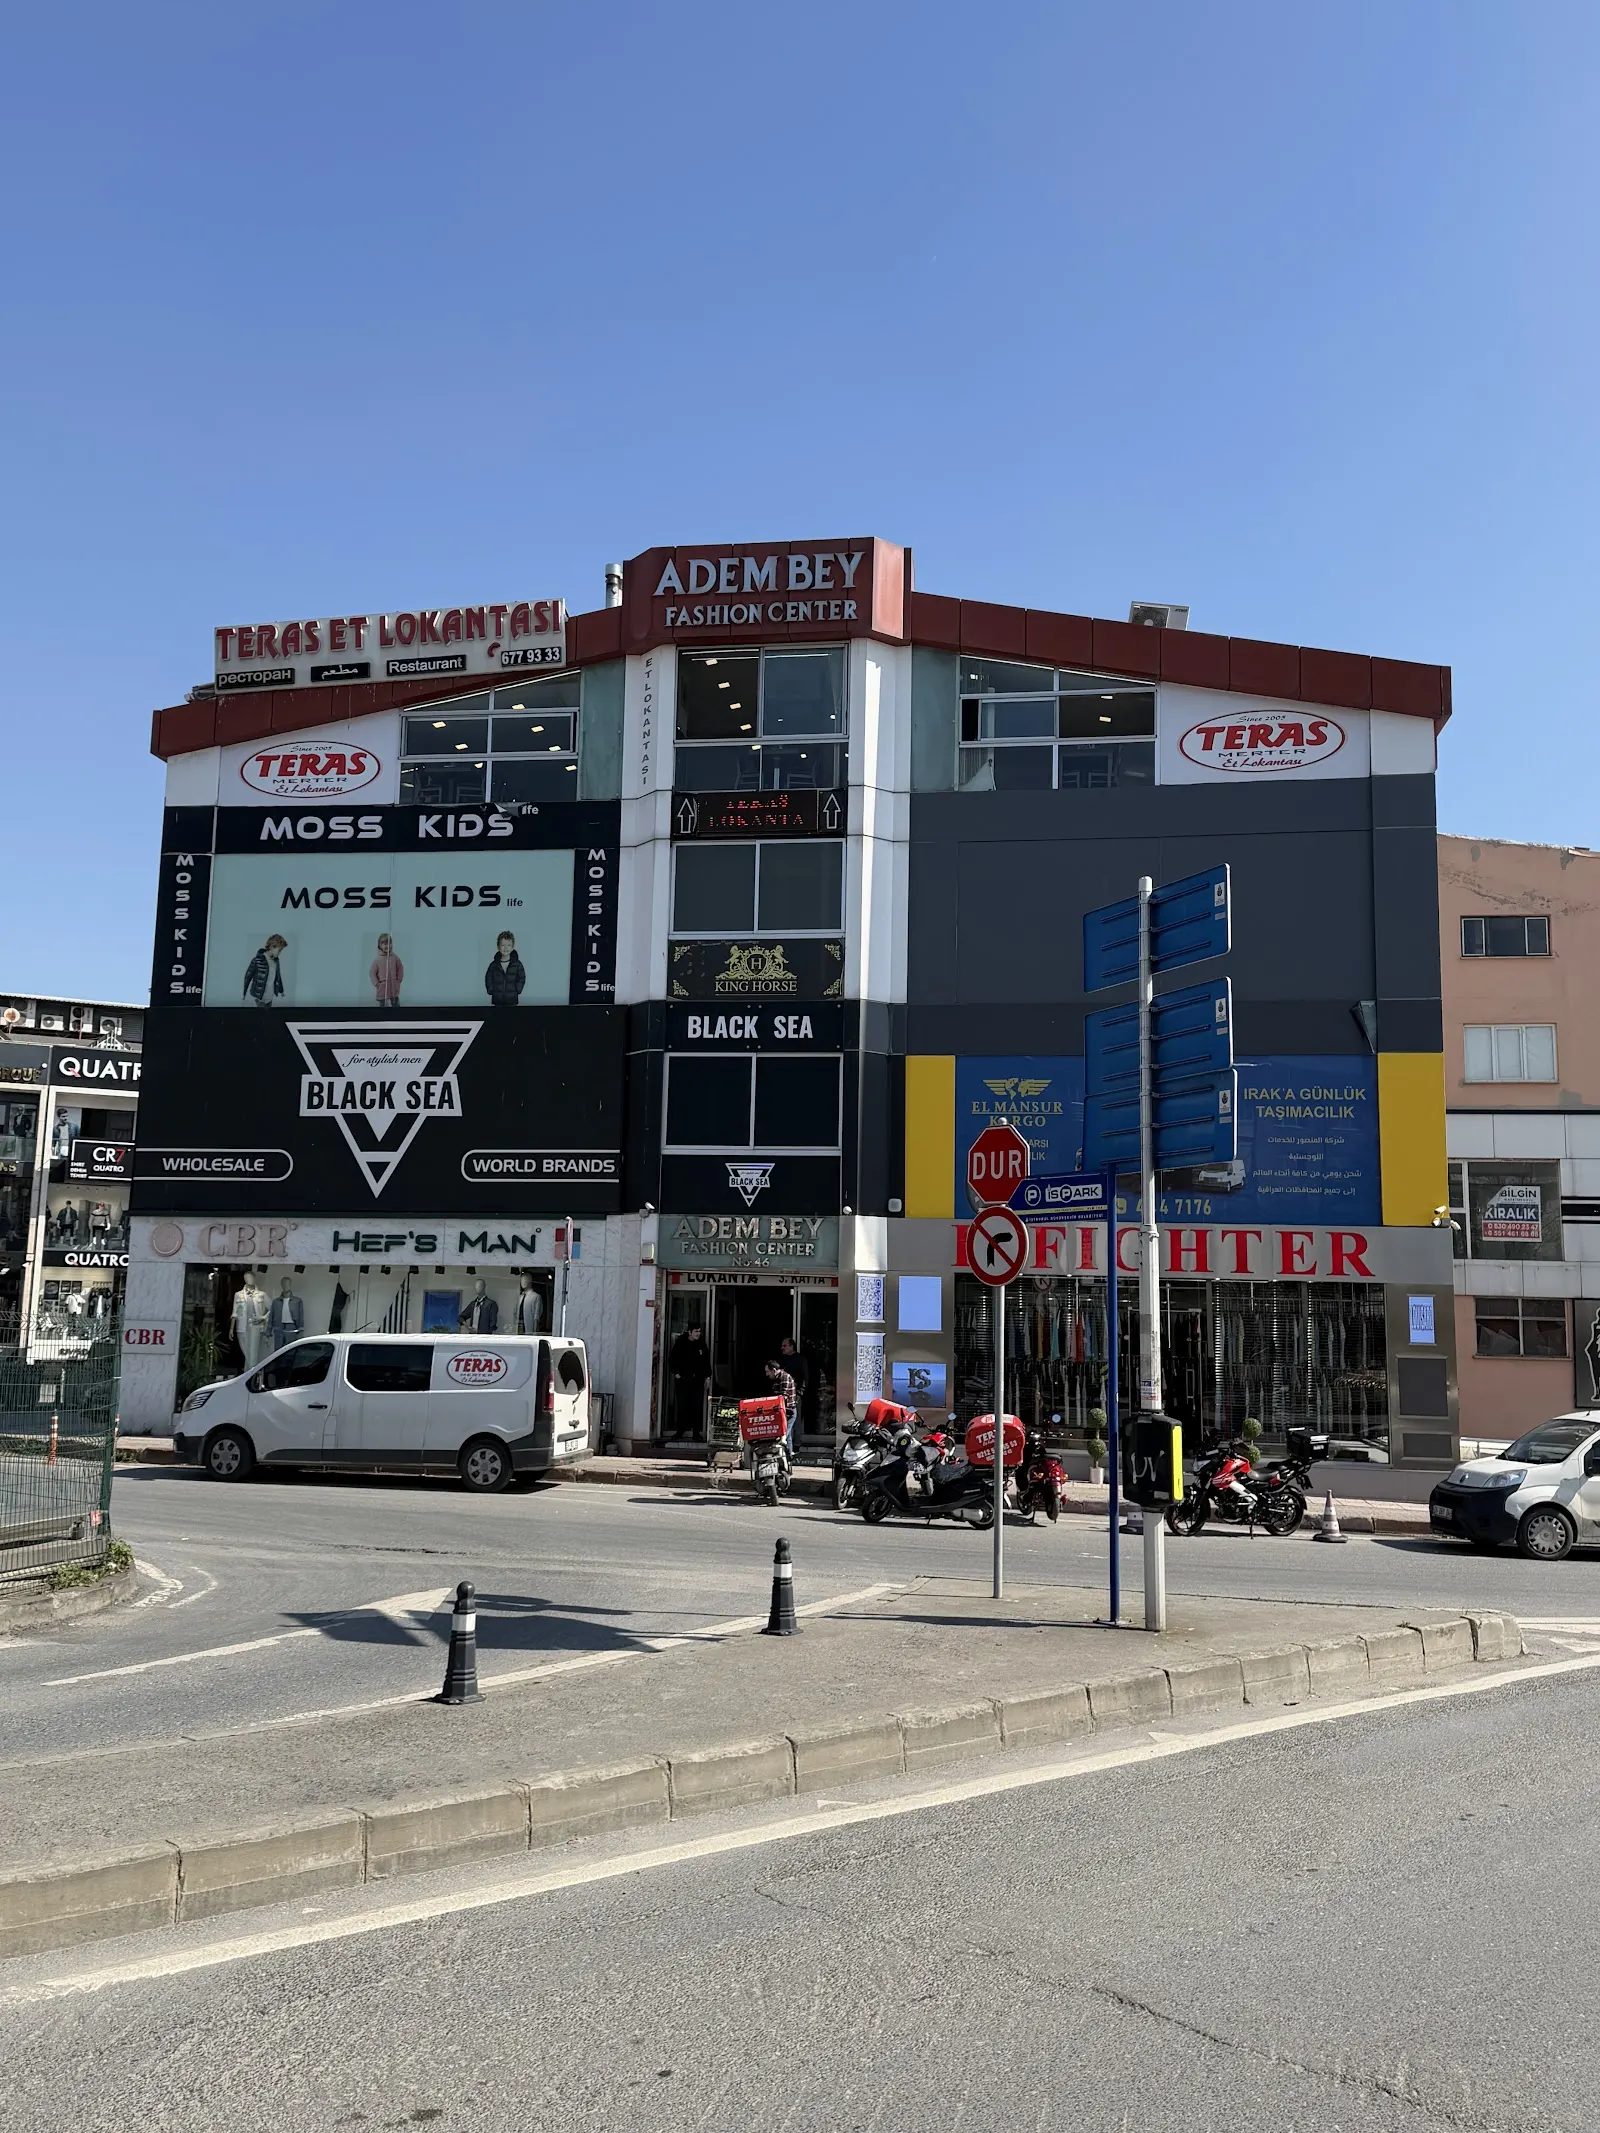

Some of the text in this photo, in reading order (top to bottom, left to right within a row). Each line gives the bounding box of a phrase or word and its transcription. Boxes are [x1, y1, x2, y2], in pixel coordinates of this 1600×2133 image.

[653, 551, 866, 597] ADEM BEY
[664, 600, 858, 627] FASHION CENTER
[216, 600, 562, 660] TERAS ET LOKANTASI
[502, 647, 560, 665] 677 93 33
[321, 664, 359, 680] مطعم
[389, 657, 463, 673] Restaurant
[218, 670, 291, 687] ресторан
[1196, 721, 1328, 751] TERAS
[1218, 748, 1306, 757] MERTER
[255, 752, 367, 777] TERAS
[1222, 758, 1238, 768] Et
[260, 815, 383, 840] MOSS
[418, 813, 515, 838] KIDS
[280, 885, 524, 909] MOSS KIDS life
[715, 981, 798, 992] KING HORSE
[687, 1016, 813, 1039] BLACK SEA
[342, 1054, 366, 1067] for
[367, 1053, 399, 1067] stylish
[0, 1067, 41, 1082] ROUP
[306, 1080, 455, 1110] BLACK SEA
[1243, 1085, 1366, 1100] IRAK'A GÜNLÜK
[972, 1101, 1063, 1113] EL MANSUR
[1255, 1105, 1355, 1120] TAŞIMACILIK
[990, 1115, 1046, 1127] KRGO
[93, 1147, 126, 1163] CR7
[93, 1164, 125, 1173] QUATRO
[162, 1157, 265, 1172] WHOLESALE
[472, 1159, 616, 1173] WORLD BRANDS
[972, 1149, 1022, 1180] DUR
[731, 1177, 769, 1186] BLACK SEA
[1501, 1187, 1537, 1198] BİLGİN
[1175, 1198, 1212, 1215] 7176
[672, 1216, 825, 1240] ADEM BEY
[200, 1223, 289, 1257] CBR
[333, 1230, 537, 1254] HEF'S MAN
[681, 1241, 816, 1256] FASHION CENTER
[125, 1329, 166, 1346] CBR
[454, 1358, 502, 1373] TERAS
[748, 1414, 775, 1424] TERAS
